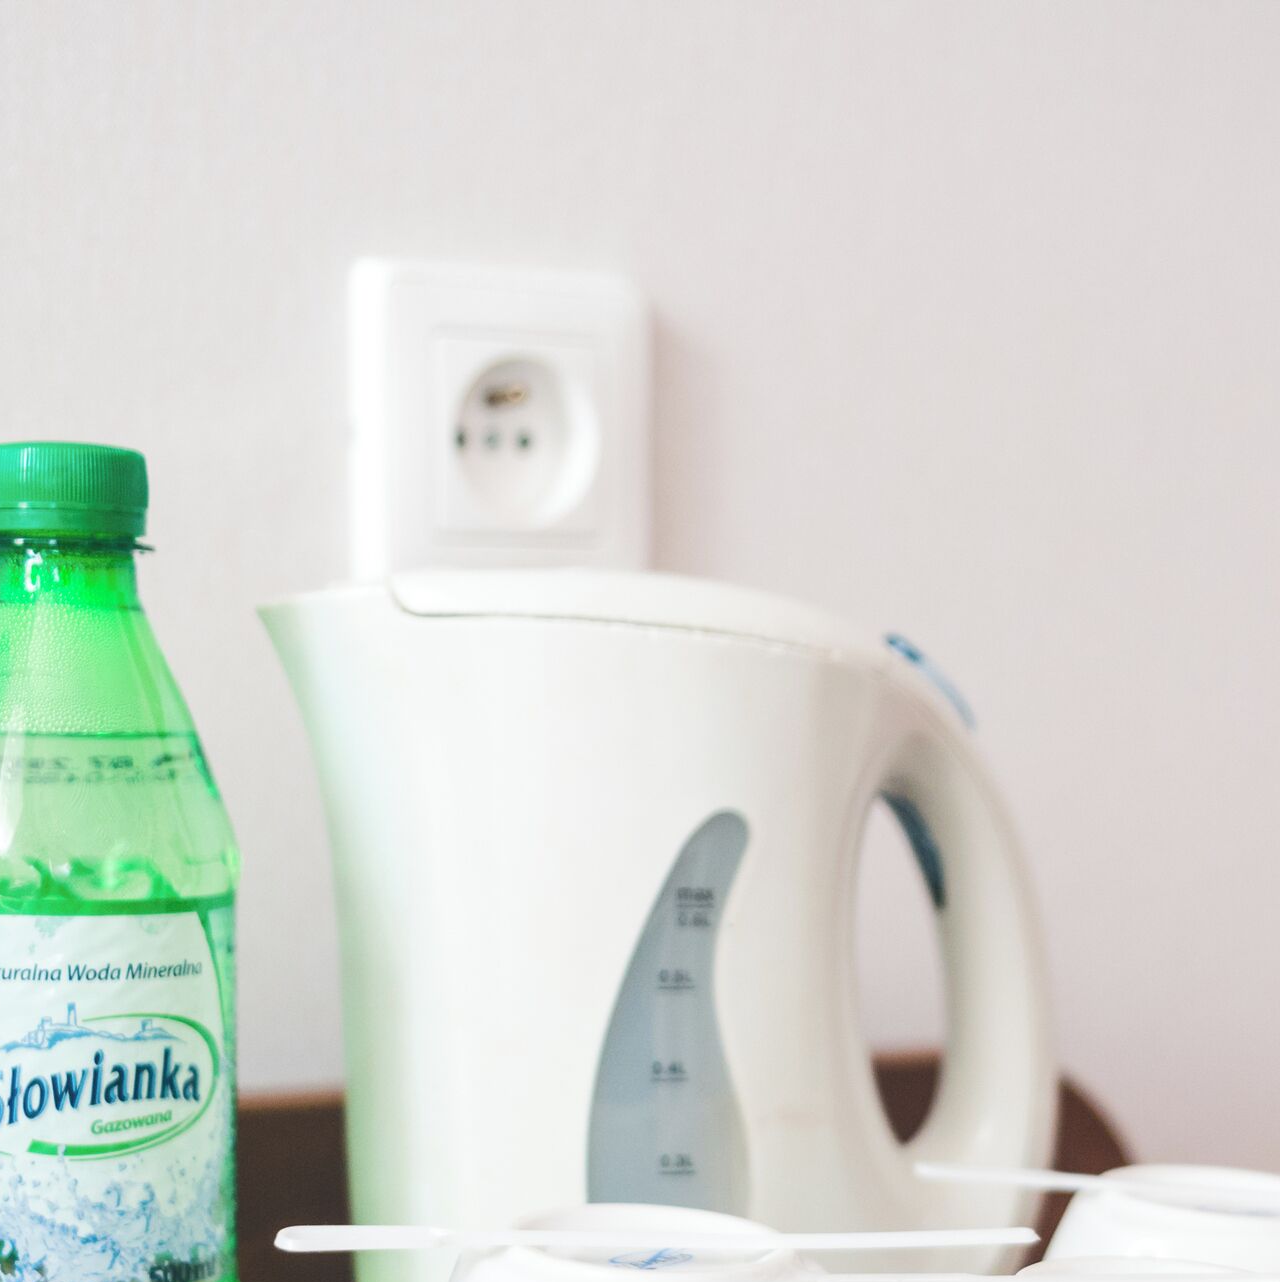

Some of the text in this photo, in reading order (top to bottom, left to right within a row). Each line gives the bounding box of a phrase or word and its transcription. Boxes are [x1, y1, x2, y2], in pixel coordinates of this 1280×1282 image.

[67, 962, 121, 981] Woda
[125, 958, 203, 979] Mineralna
[90, 1109, 173, 1136] Gazowana
